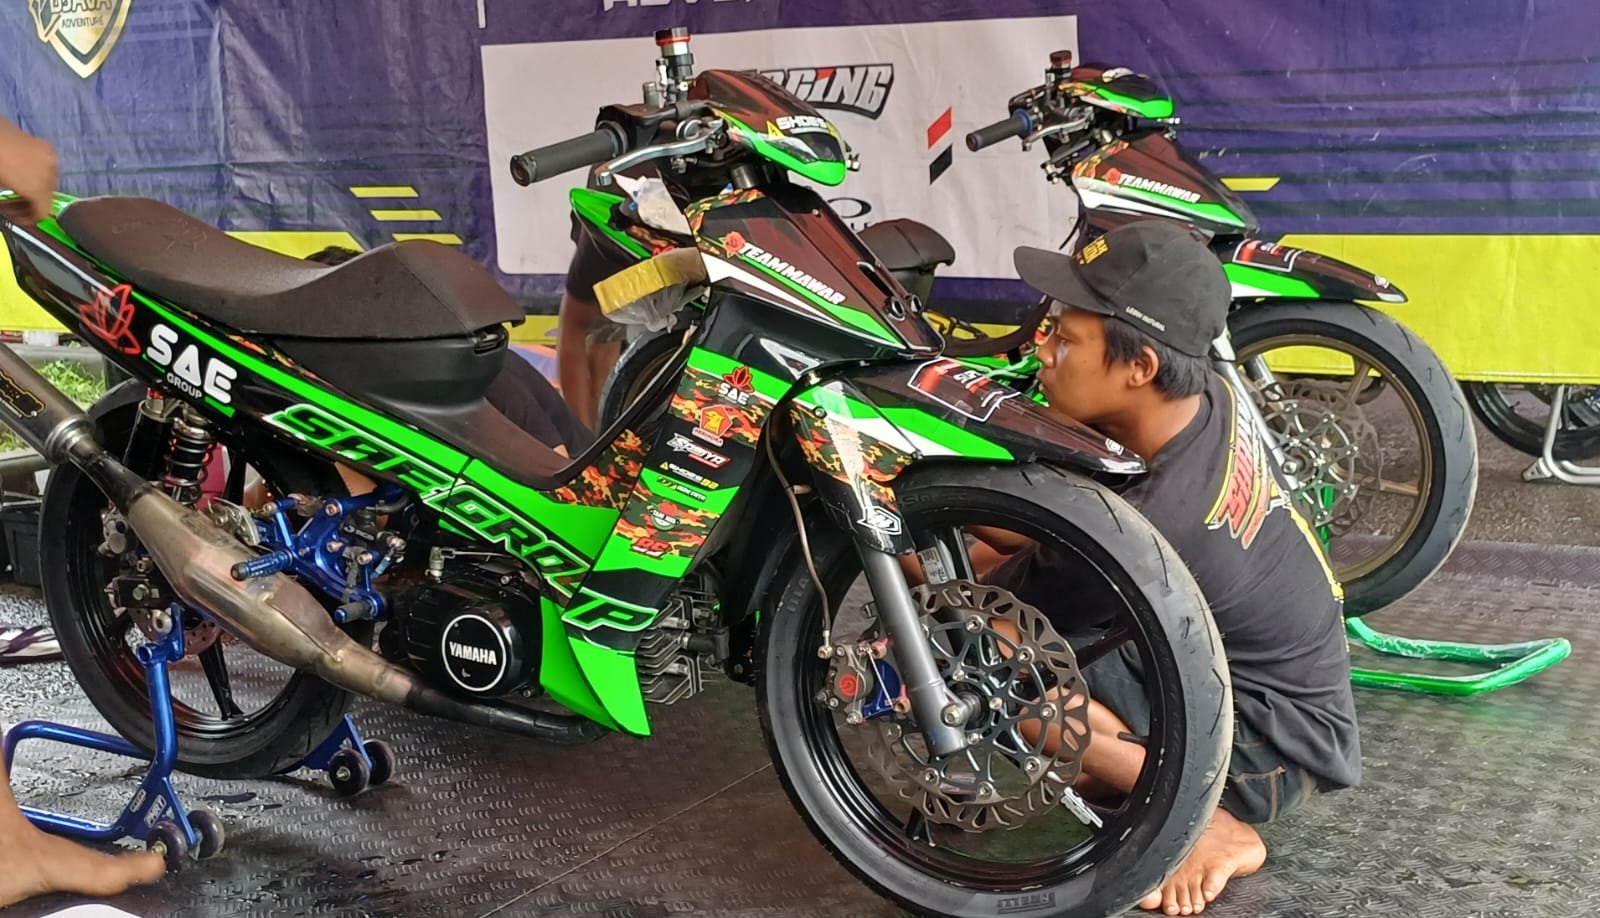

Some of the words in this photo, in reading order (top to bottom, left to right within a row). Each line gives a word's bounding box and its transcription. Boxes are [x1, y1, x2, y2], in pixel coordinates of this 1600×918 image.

[62, 16, 104, 28] ADVENTURE
[739, 242, 846, 305] TEAMMAWAR
[147, 323, 238, 404] SAE
[166, 372, 203, 399] GROUP
[719, 382, 750, 405] SAE
[449, 641, 497, 666] YAMAHA
